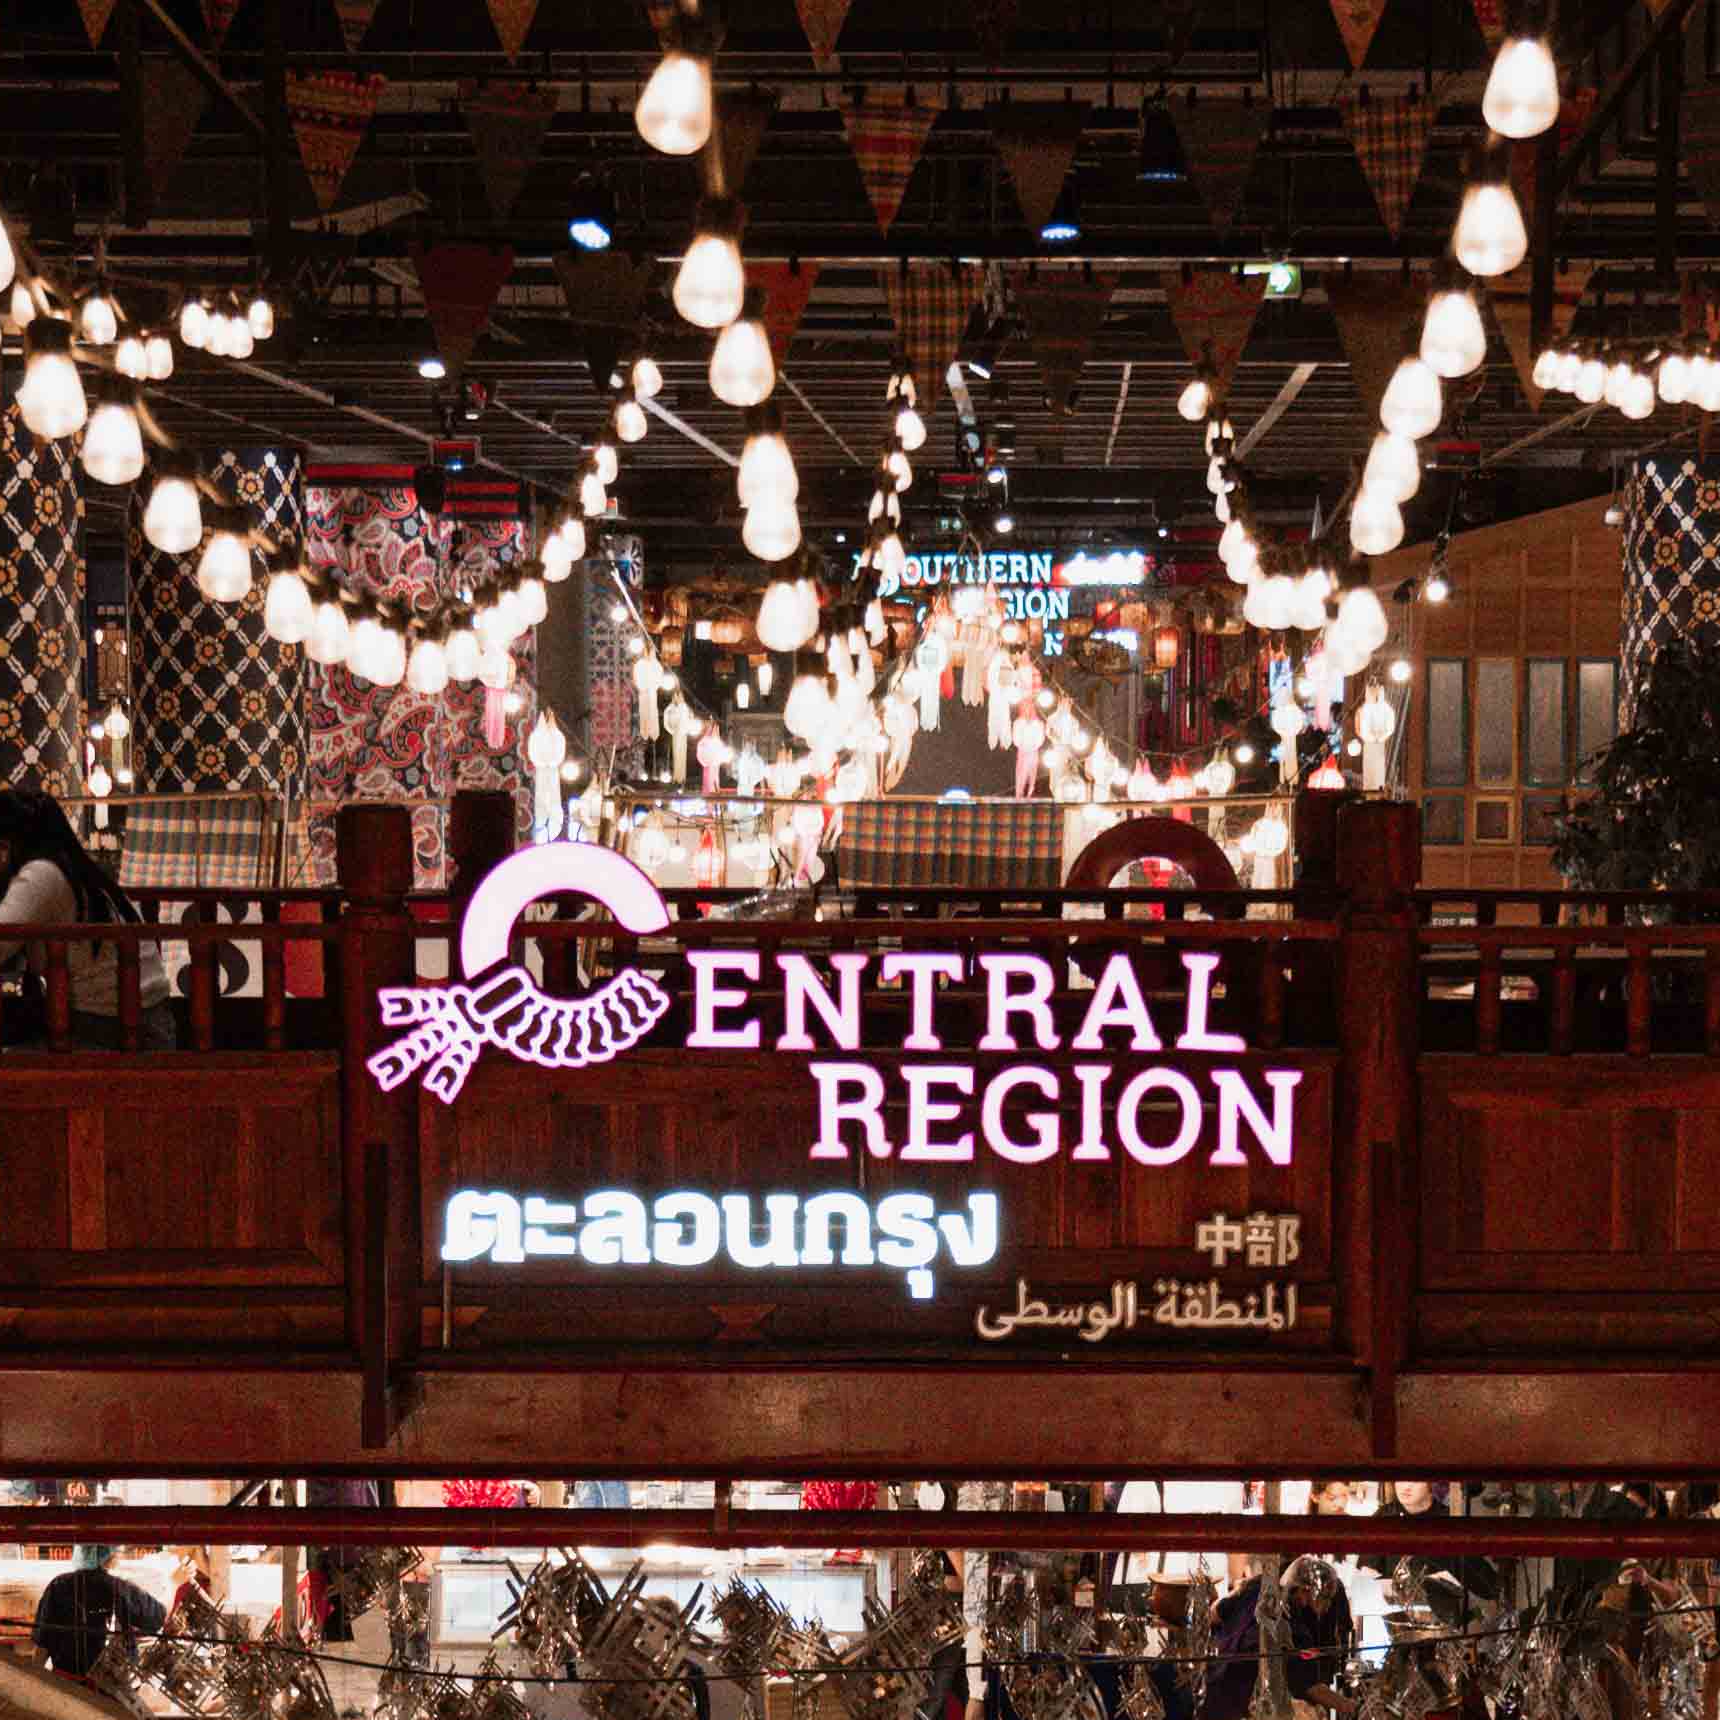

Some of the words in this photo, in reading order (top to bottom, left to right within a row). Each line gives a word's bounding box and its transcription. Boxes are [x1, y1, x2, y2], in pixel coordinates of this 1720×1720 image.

[365, 840, 1246, 1103] CENTRAL
[808, 1063, 1303, 1166] REGION
[441, 1186, 999, 1300] ตะลอนกรุง
[1196, 1213, 1301, 1268] 中部
